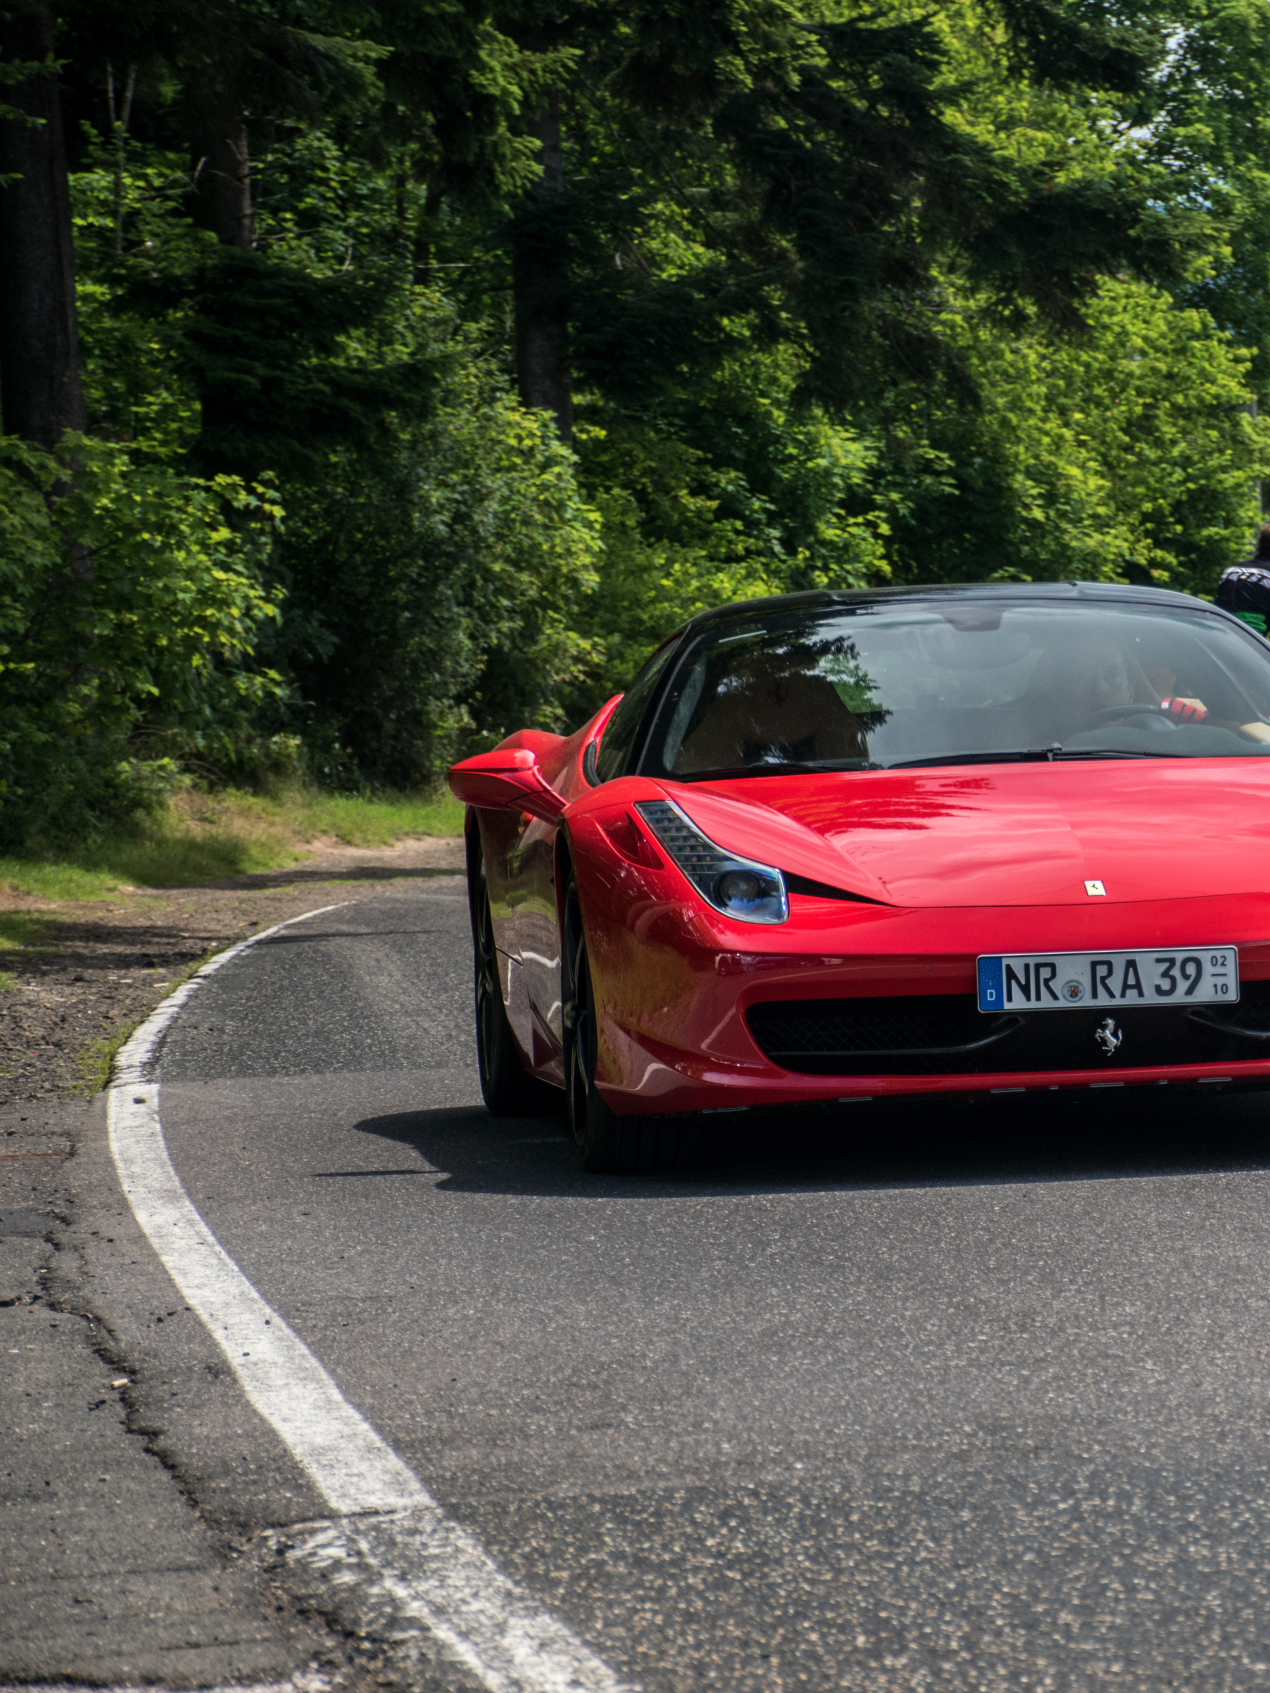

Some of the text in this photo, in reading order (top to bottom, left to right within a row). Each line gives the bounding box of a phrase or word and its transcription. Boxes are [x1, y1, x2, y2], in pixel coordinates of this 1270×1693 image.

[1210, 955, 1228, 967] 02
[1005, 956, 1203, 1002] NR RA 39
[987, 989, 996, 1001] D
[1213, 983, 1229, 995] 10
